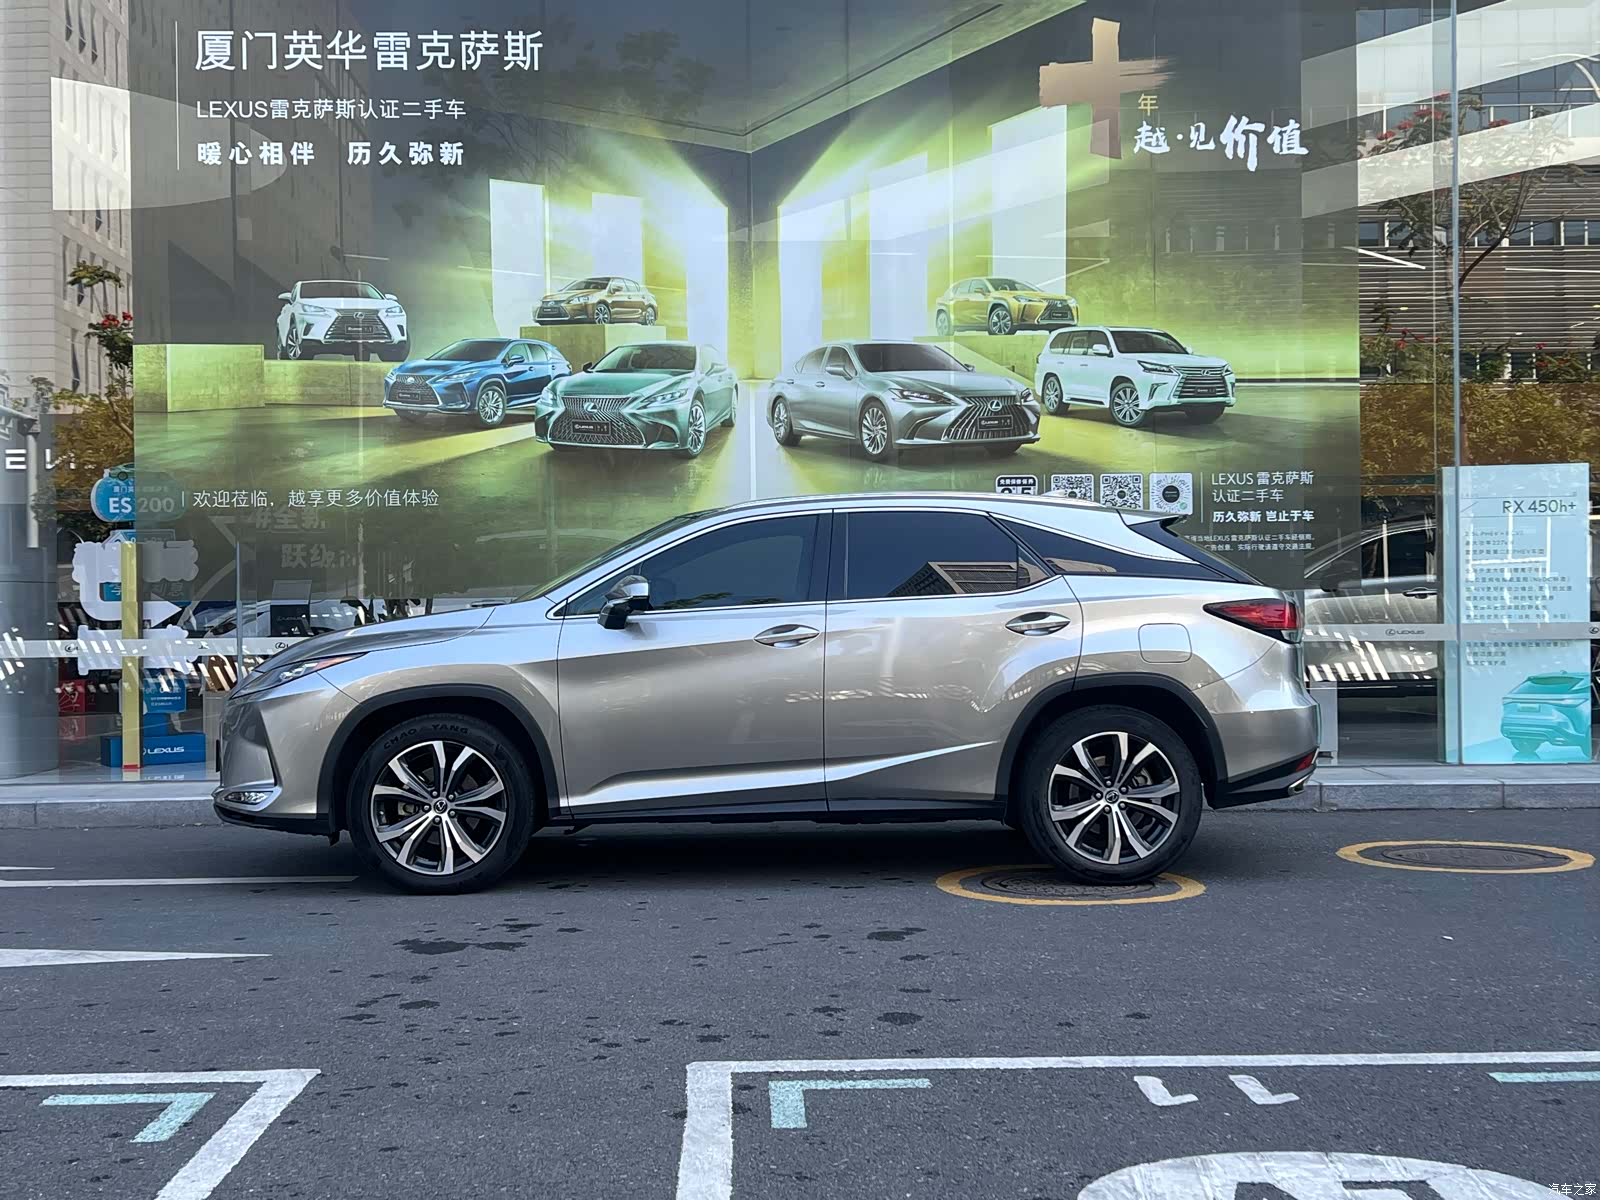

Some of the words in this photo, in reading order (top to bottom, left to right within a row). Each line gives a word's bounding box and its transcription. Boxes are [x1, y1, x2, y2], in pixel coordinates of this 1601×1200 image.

[195, 30, 544, 71] 厦门英华雷克萨斯
[1137, 93, 1158, 116] 年
[197, 142, 316, 166] 暖心相伴
[347, 142, 464, 166] 历久弥新
[1211, 473, 1254, 485] LEXUS
[1257, 471, 1314, 485] 雷克萨斯
[1212, 489, 1284, 502] 认证二手车
[109, 497, 132, 513] ES
[138, 497, 175, 513] 200
[1502, 500, 1525, 513] RX
[1528, 499, 1577, 513] 450h+
[1212, 510, 1262, 522] 历久弥新
[1265, 510, 1315, 522] 岂止于车
[147, 746, 185, 754] LEXUS
